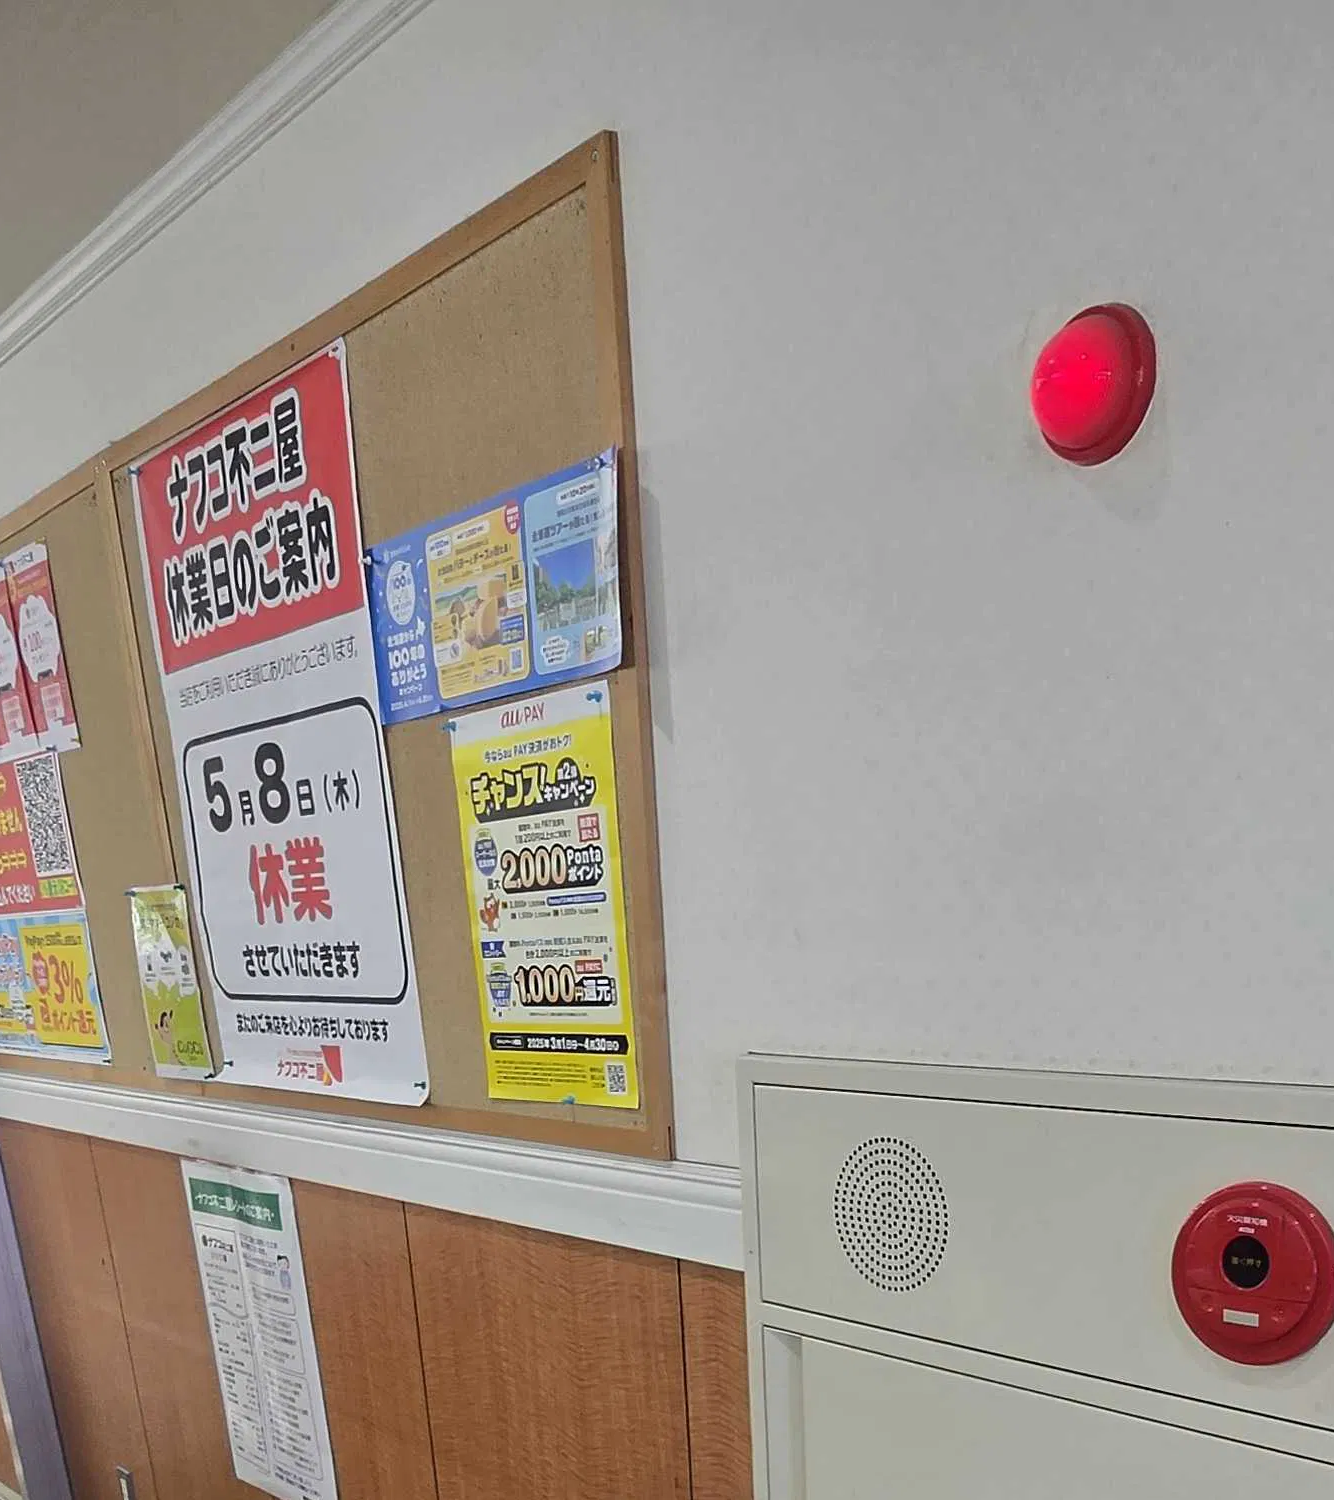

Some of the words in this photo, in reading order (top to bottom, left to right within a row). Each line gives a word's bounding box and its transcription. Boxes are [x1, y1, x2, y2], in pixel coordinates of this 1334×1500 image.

[168, 396, 305, 540] ナフコ不二屋
[166, 496, 338, 643] 休業日のご案内
[524, 703, 545, 721] PAY
[543, 778, 596, 802] キャンペーン
[501, 844, 566, 891] 2,000
[566, 847, 603, 866] Ponta
[567, 864, 605, 882] ポイント
[248, 836, 334, 926] 休業
[47, 954, 85, 1005] 3%
[242, 942, 362, 980] させていただきます
[236, 1013, 390, 1042] またのご来店を心よりお待ちしております
